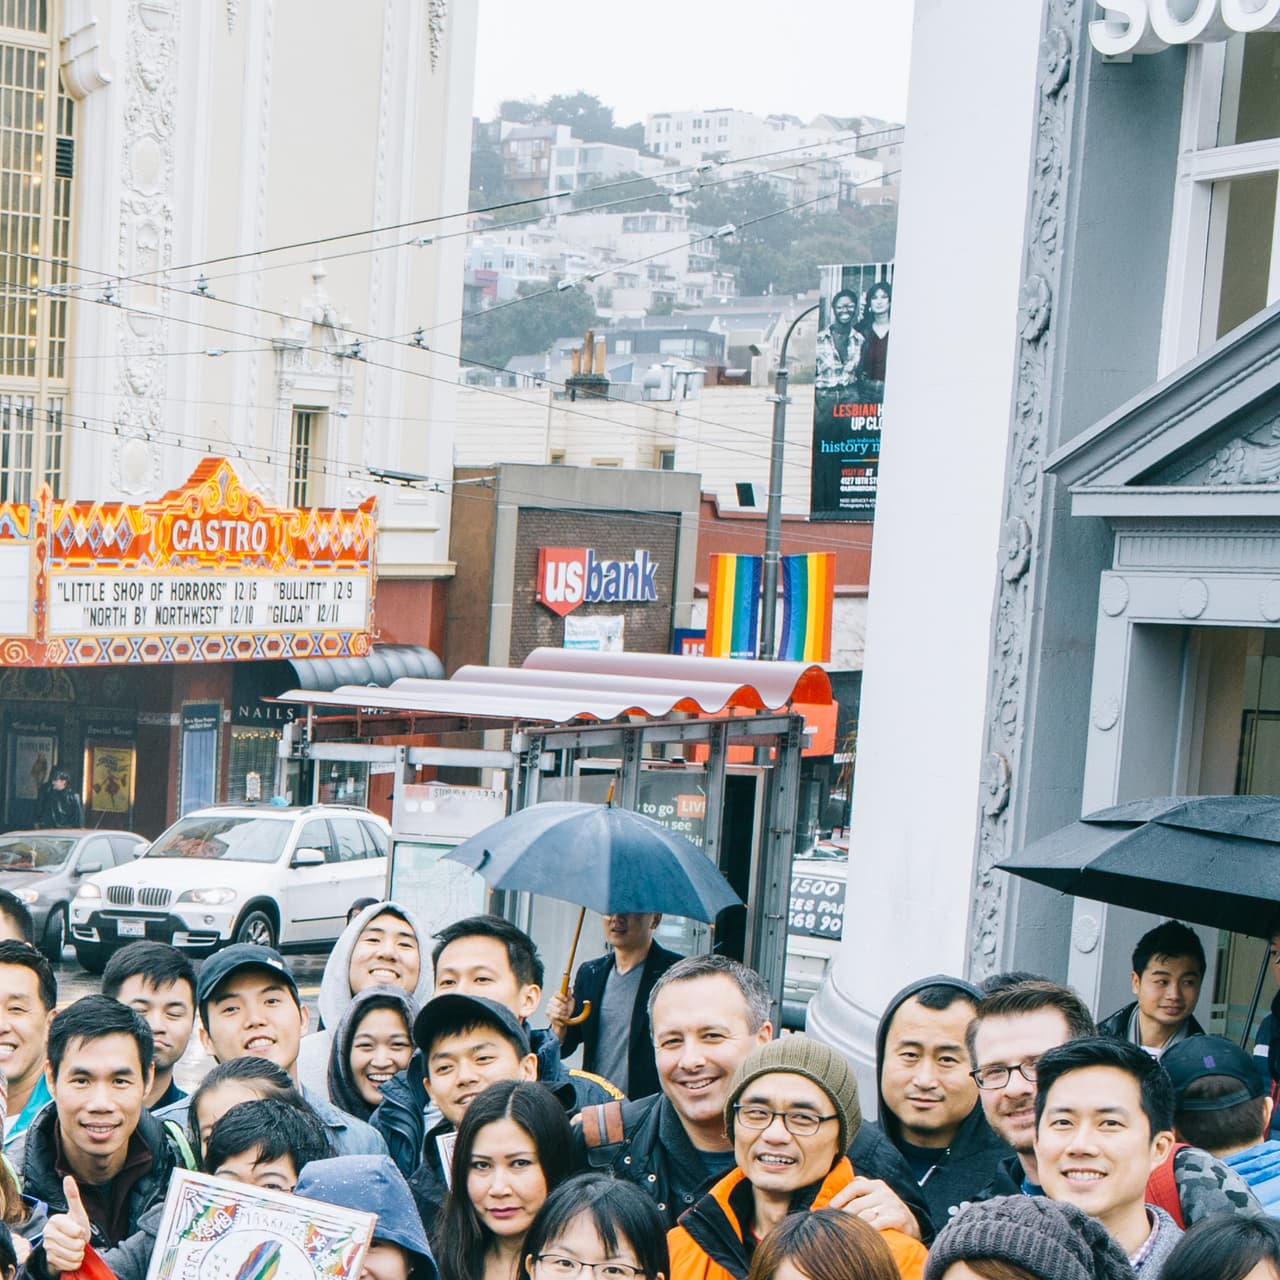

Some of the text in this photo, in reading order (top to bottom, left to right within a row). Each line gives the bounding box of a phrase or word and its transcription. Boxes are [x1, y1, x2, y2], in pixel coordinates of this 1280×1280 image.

[833, 404, 877, 417] LESBIAN
[851, 417, 865, 430] UP
[821, 440, 869, 455] history
[172, 520, 267, 551] CASTRO
[113, 583, 144, 602] SHOP
[150, 583, 164, 601] OF
[134, 606, 147, 626] BY
[230, 605, 254, 625] 12/10
[240, 704, 295, 720] NAILS
[643, 802, 657, 813] to
[658, 804, 674, 817] go
